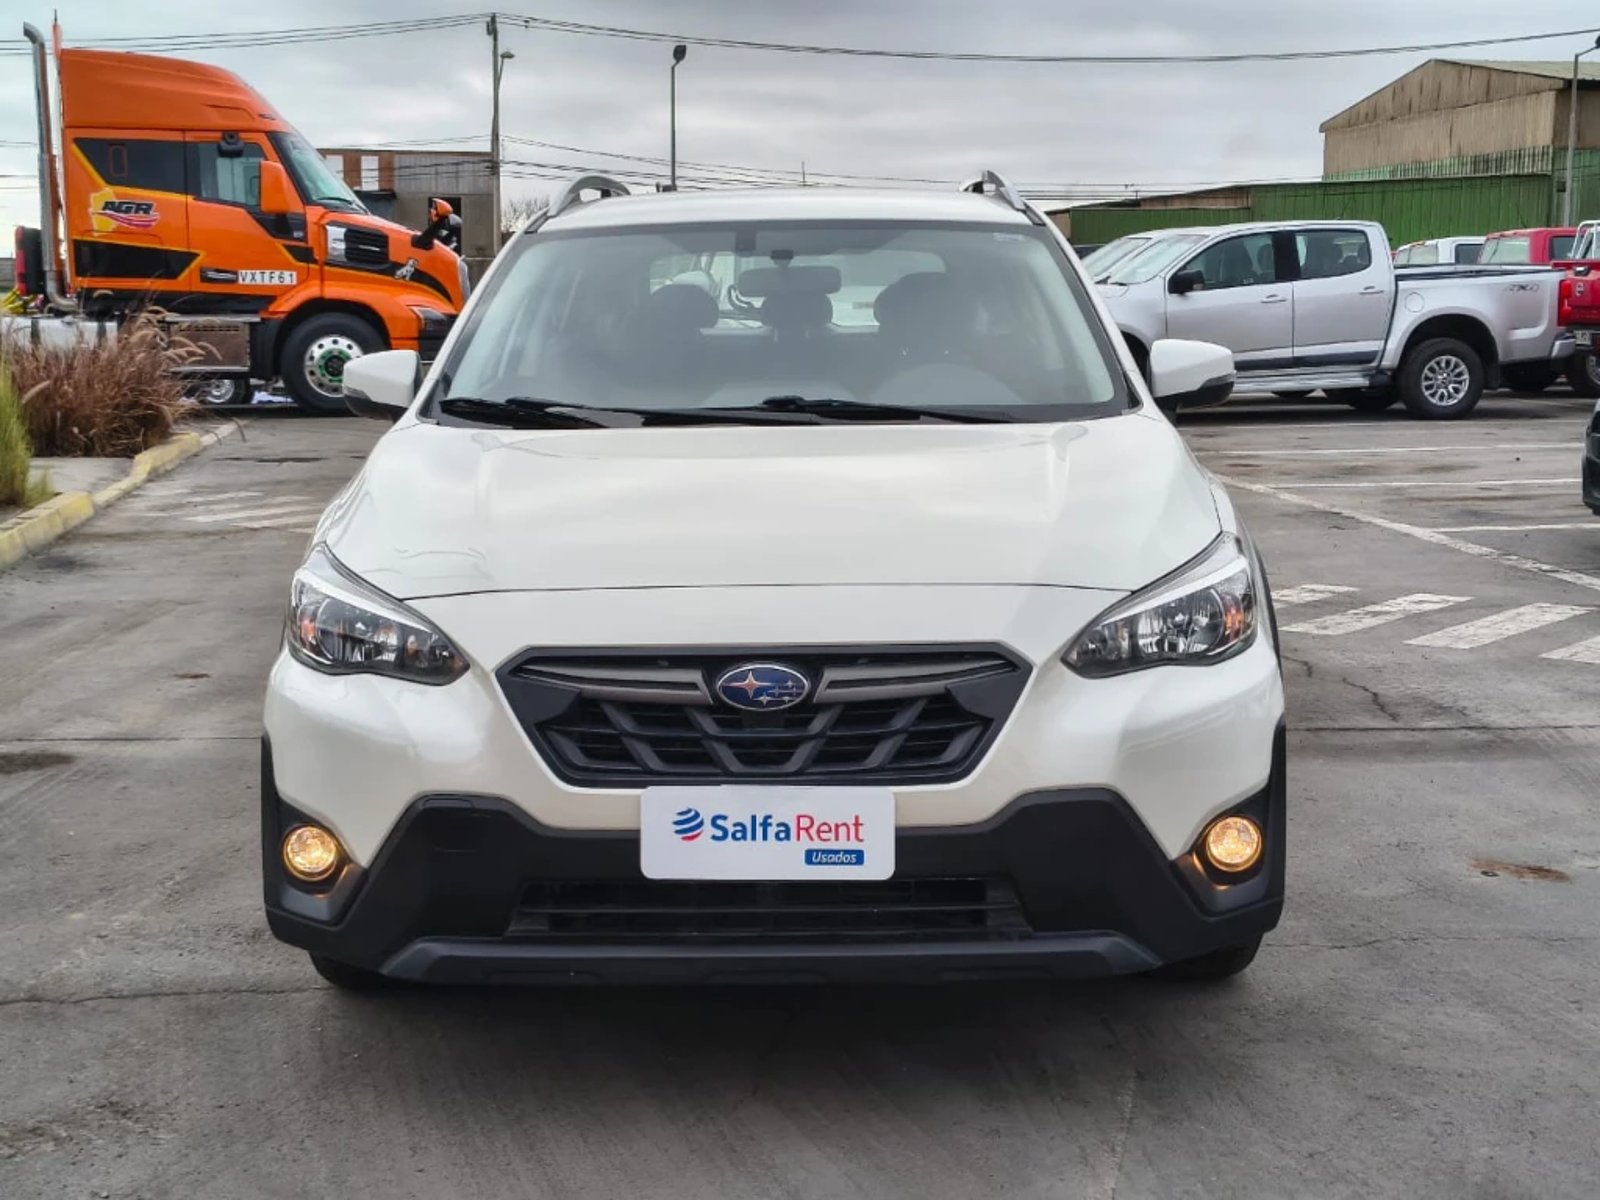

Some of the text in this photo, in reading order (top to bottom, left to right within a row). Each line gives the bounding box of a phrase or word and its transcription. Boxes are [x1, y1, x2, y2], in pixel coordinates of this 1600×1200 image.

[102, 200, 154, 215] AGR
[240, 271, 294, 283] VXTF61
[812, 851, 857, 863] Usados
